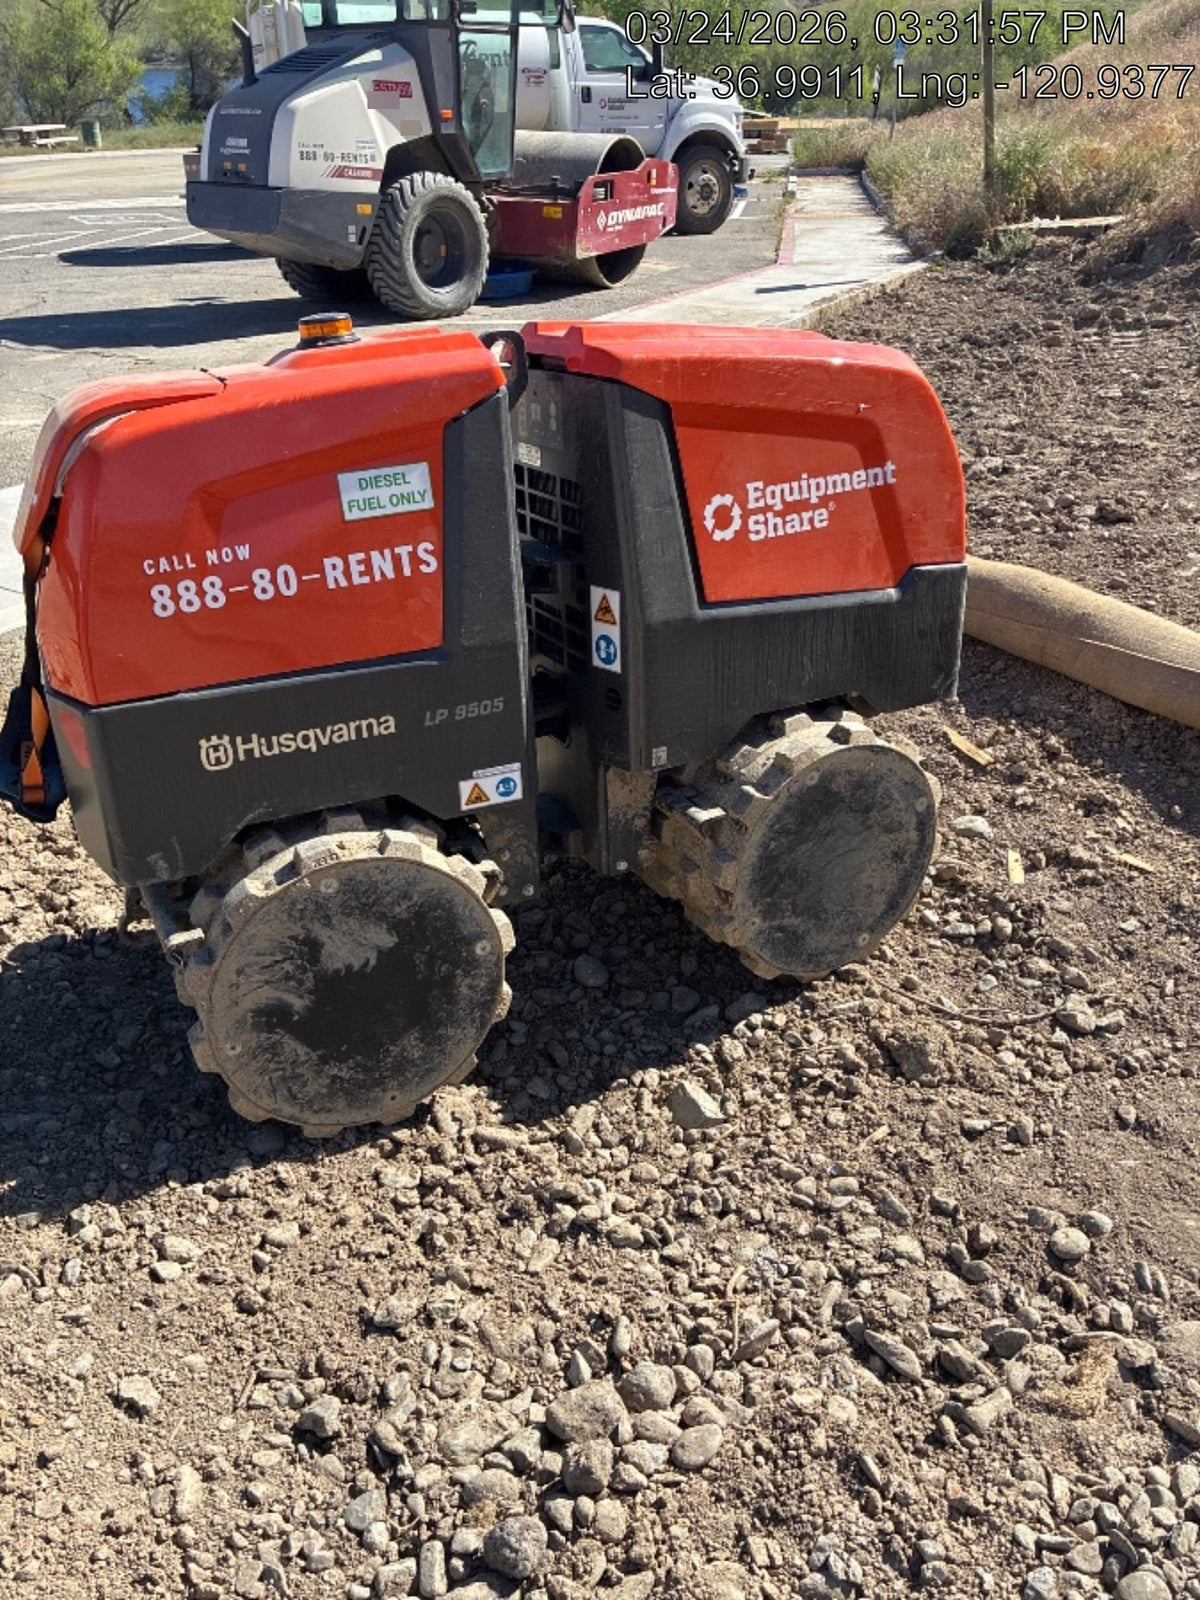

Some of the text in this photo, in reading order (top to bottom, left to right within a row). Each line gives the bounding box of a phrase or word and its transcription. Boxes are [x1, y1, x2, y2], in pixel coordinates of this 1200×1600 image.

[607, 202, 665, 226] DYNAPAC
[358, 472, 411, 491] DIESEL
[746, 460, 897, 512] Equipment
[347, 488, 428, 513] FUEL ONLY
[143, 543, 251, 576] CALL NOW
[150, 541, 438, 618] 888-80-RENTS
[424, 708, 449, 726] LP
[235, 714, 396, 762] Husqvarna
